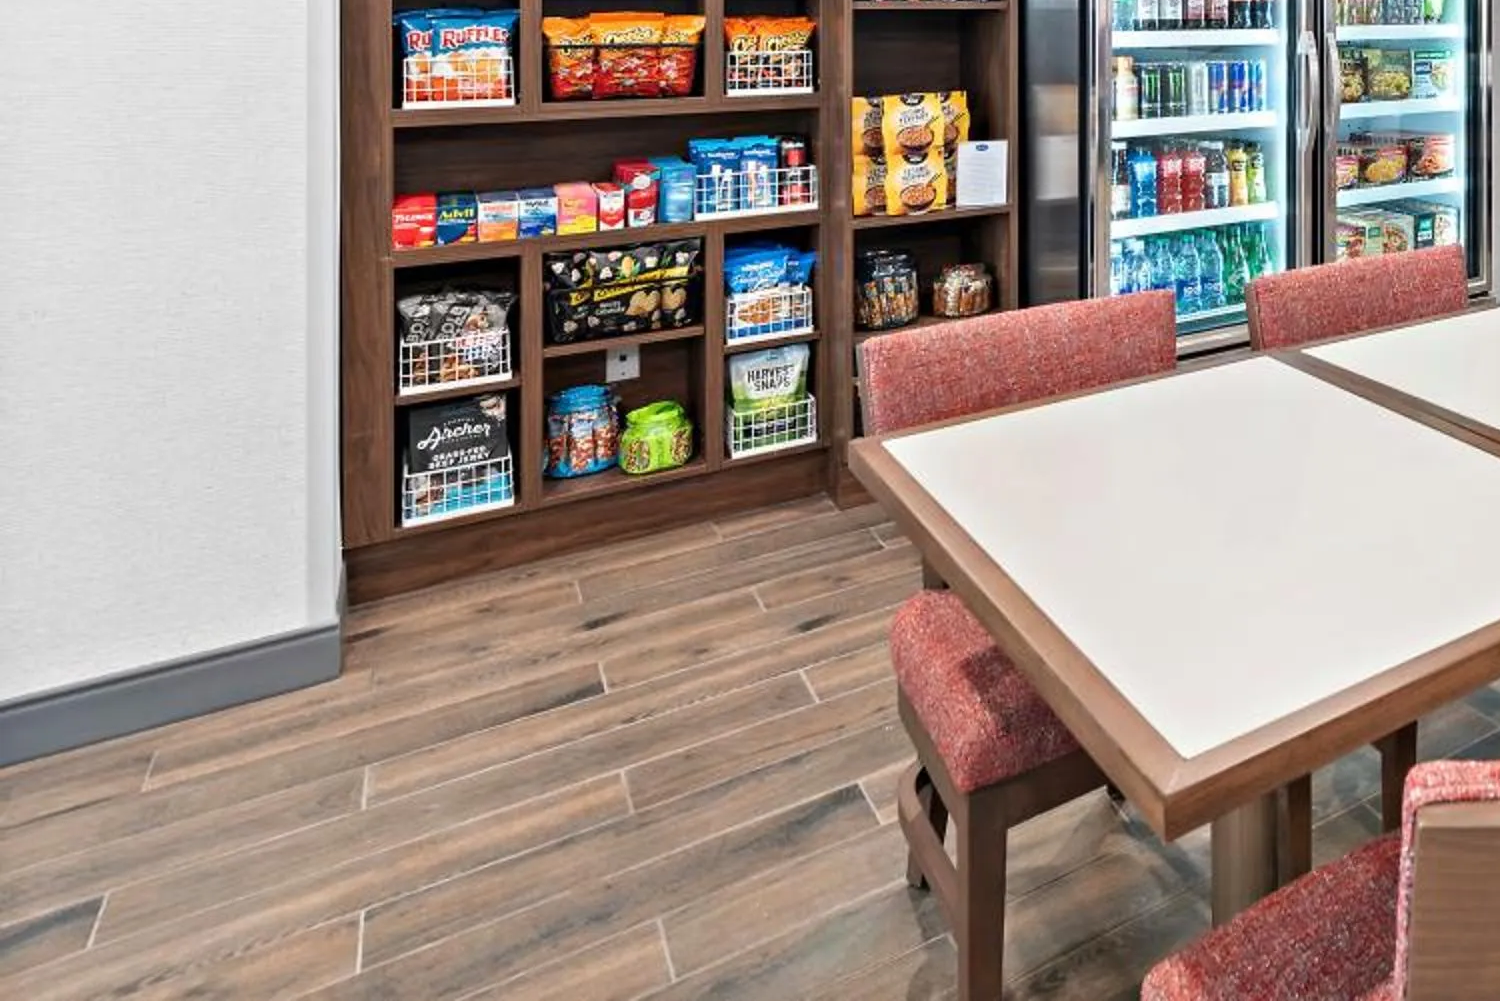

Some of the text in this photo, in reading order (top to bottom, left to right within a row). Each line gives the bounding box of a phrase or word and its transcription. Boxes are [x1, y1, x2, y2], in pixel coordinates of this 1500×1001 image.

[443, 27, 509, 47] RUFFLES
[439, 207, 474, 220] Advil
[754, 375, 791, 391] SNAPS
[416, 422, 491, 450] Archer
